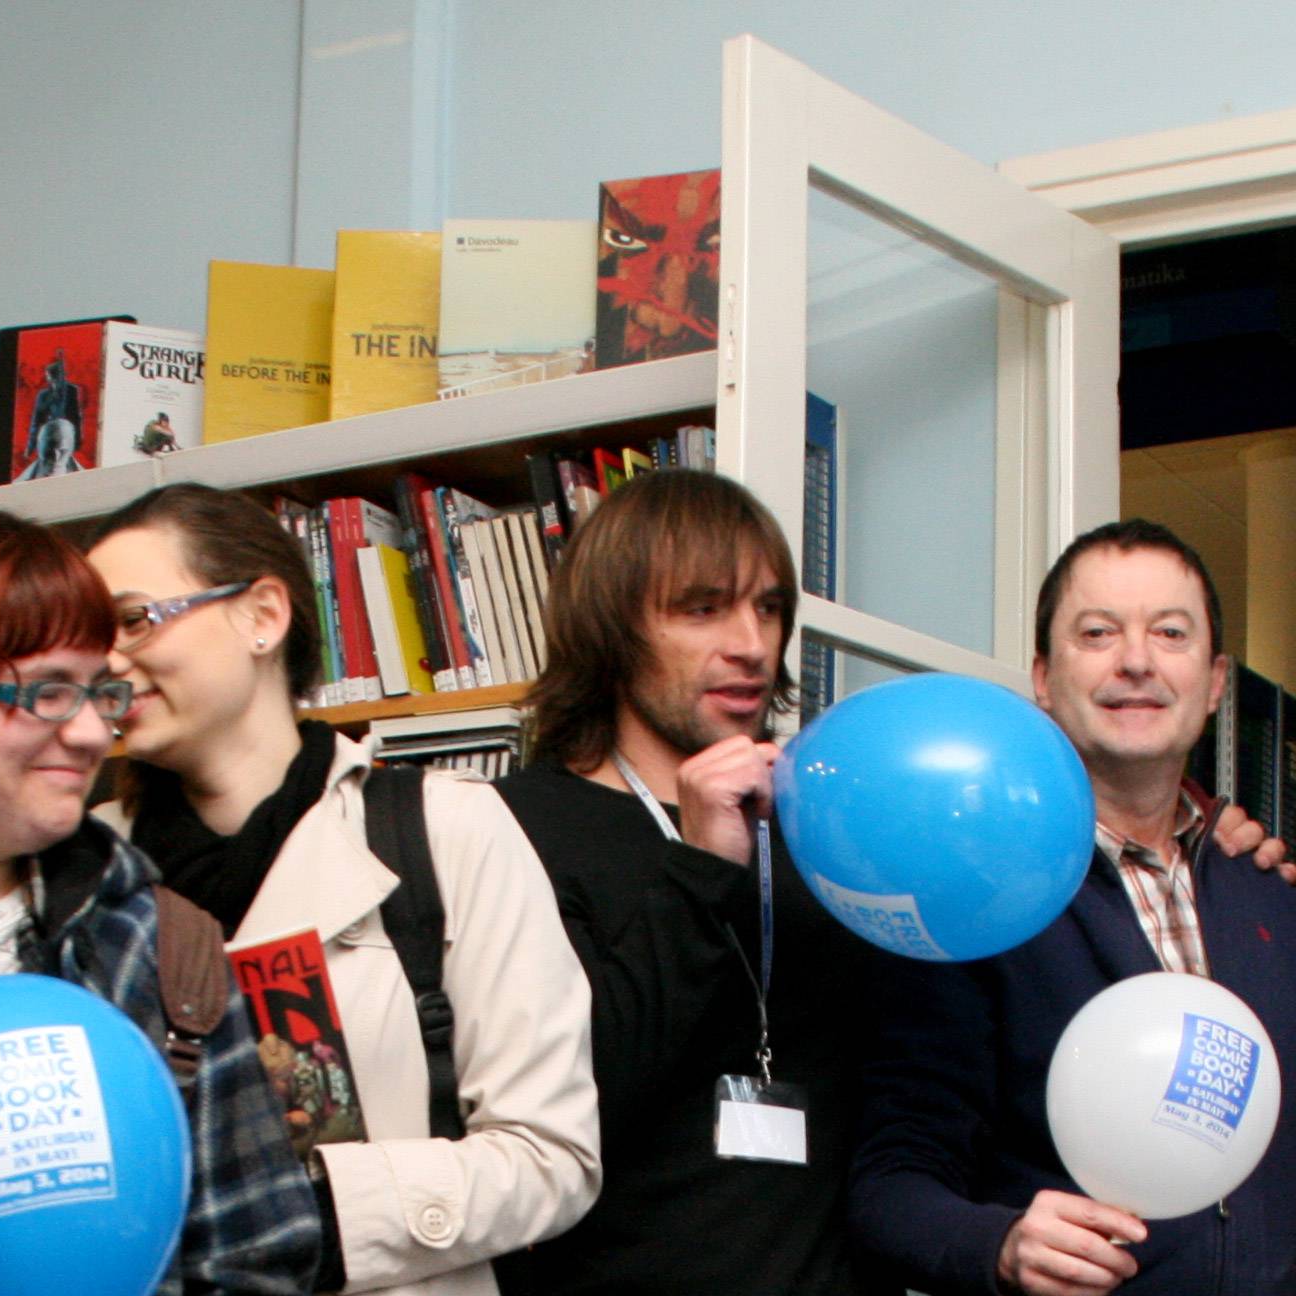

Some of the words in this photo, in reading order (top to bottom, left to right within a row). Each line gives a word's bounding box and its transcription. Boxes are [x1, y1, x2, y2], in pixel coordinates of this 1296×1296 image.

[352, 333, 401, 358] THE
[409, 334, 438, 359] IN
[139, 362, 197, 385] GIRL
[221, 362, 279, 382] BEFORE
[285, 368, 311, 383] THE
[1195, 1017, 1253, 1057] FREE
[1192, 1035, 1251, 1071] COMIC
[1189, 1049, 1249, 1087] BOOK
[1196, 1069, 1236, 1096] DAY
[8, 1104, 68, 1133] DAY
